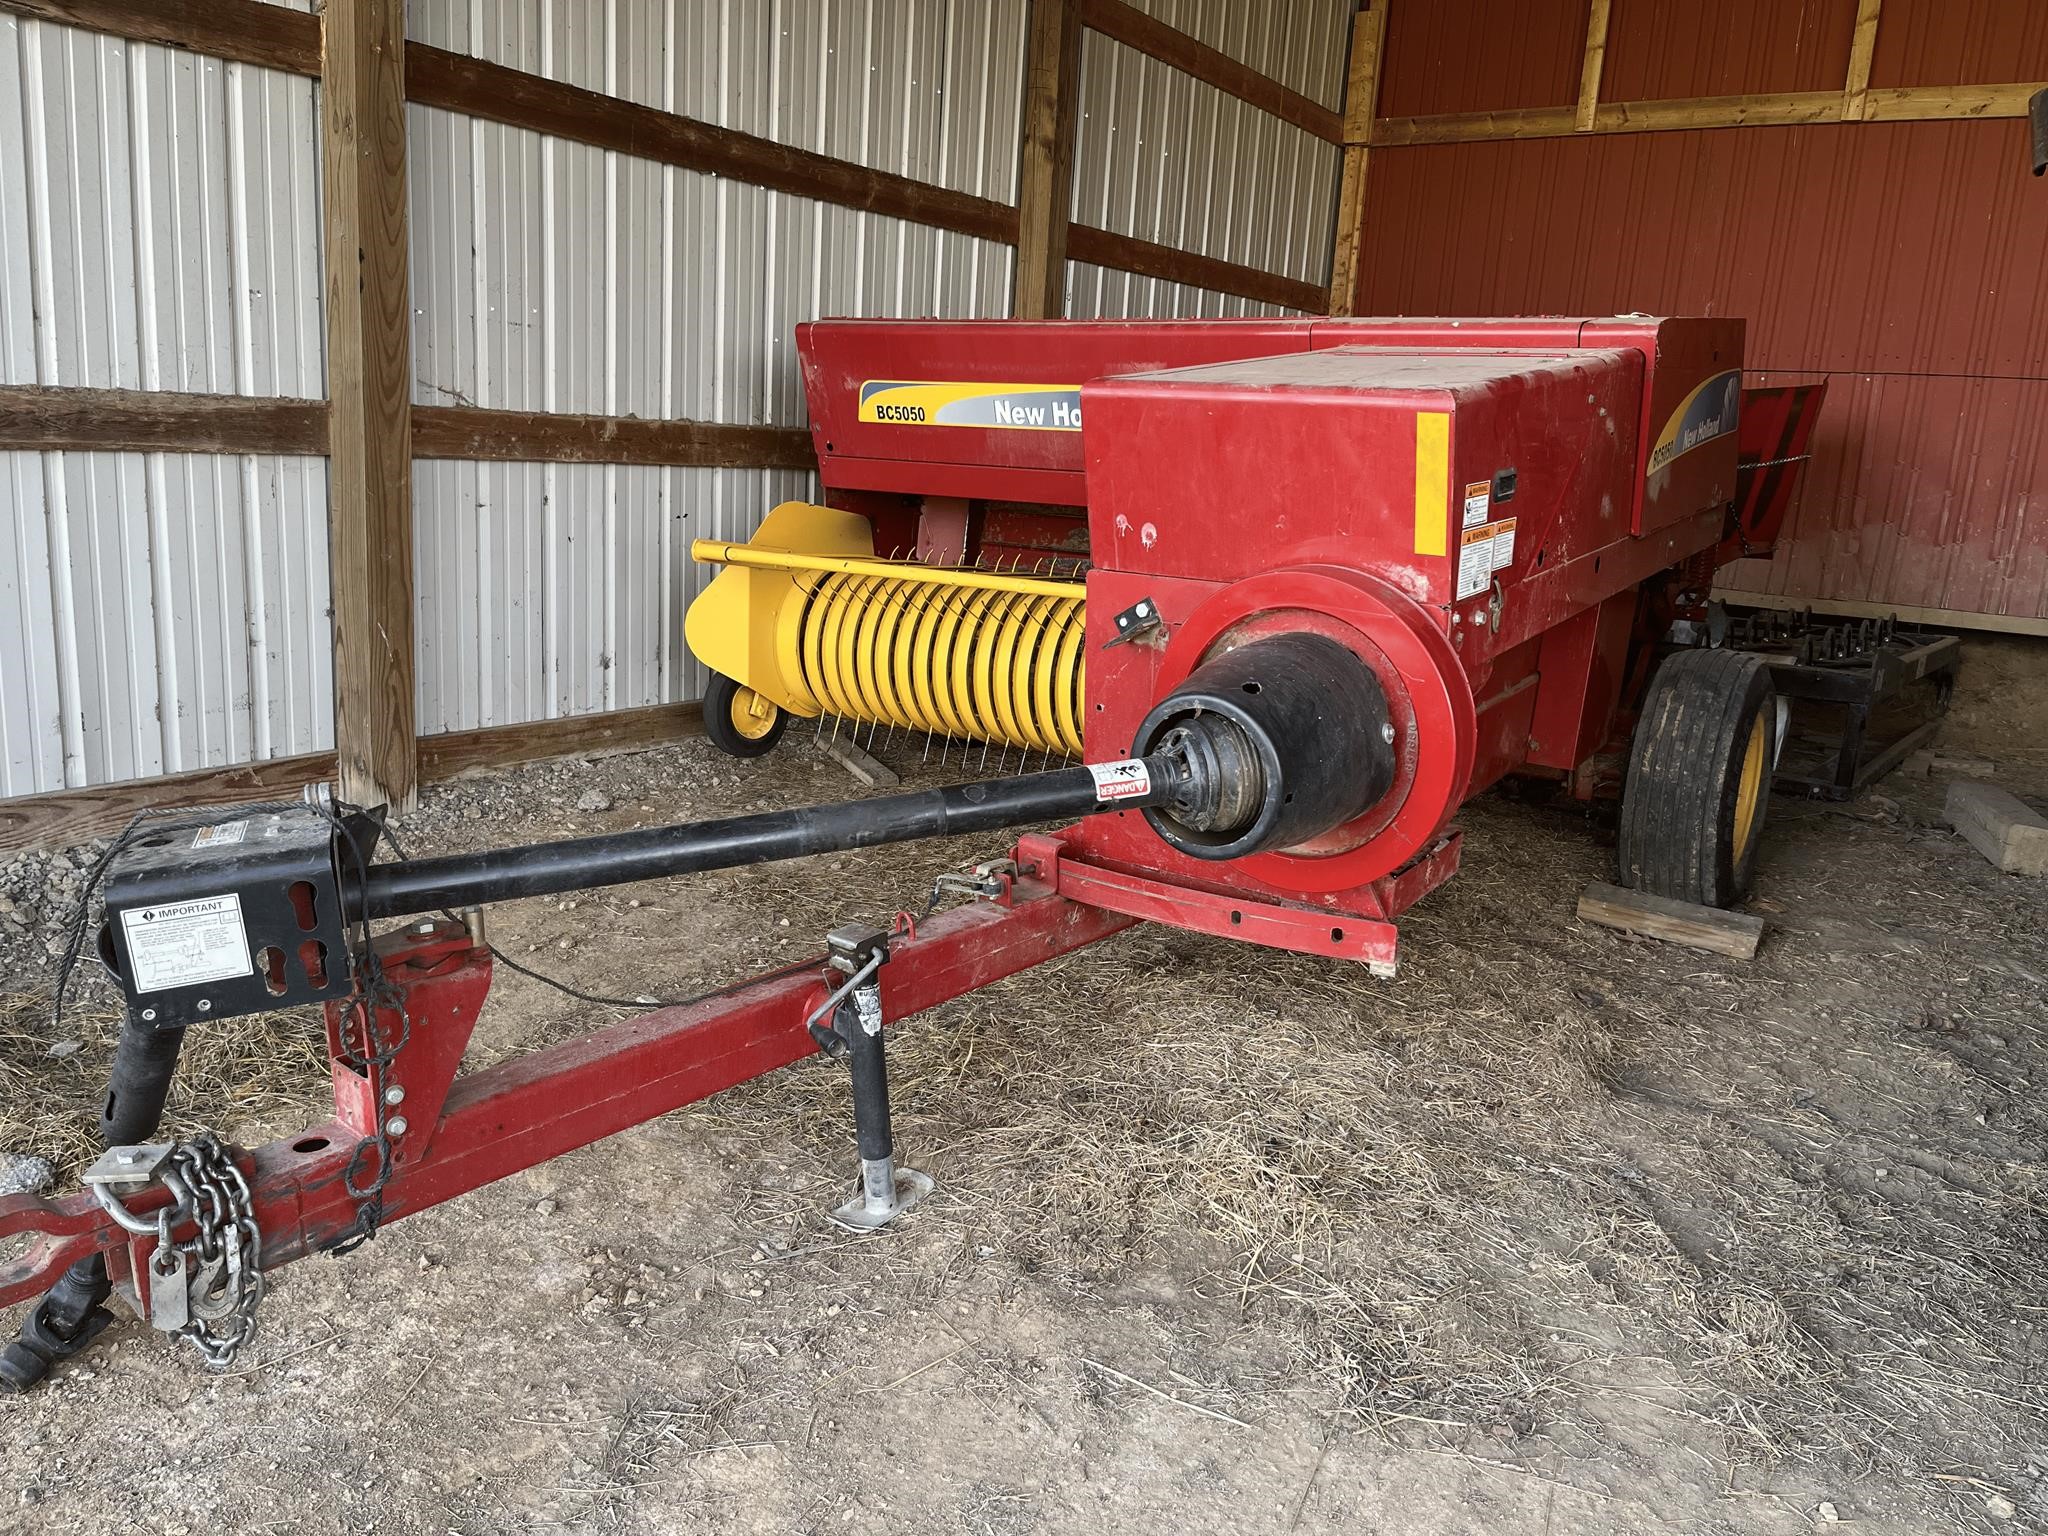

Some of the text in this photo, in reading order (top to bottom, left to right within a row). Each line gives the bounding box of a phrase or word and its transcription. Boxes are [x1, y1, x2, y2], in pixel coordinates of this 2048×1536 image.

[876, 404, 925, 422] BC5050
[993, 399, 1045, 425] New
[1100, 781, 1136, 796] DANGER
[158, 901, 223, 919] IMPORTANT
